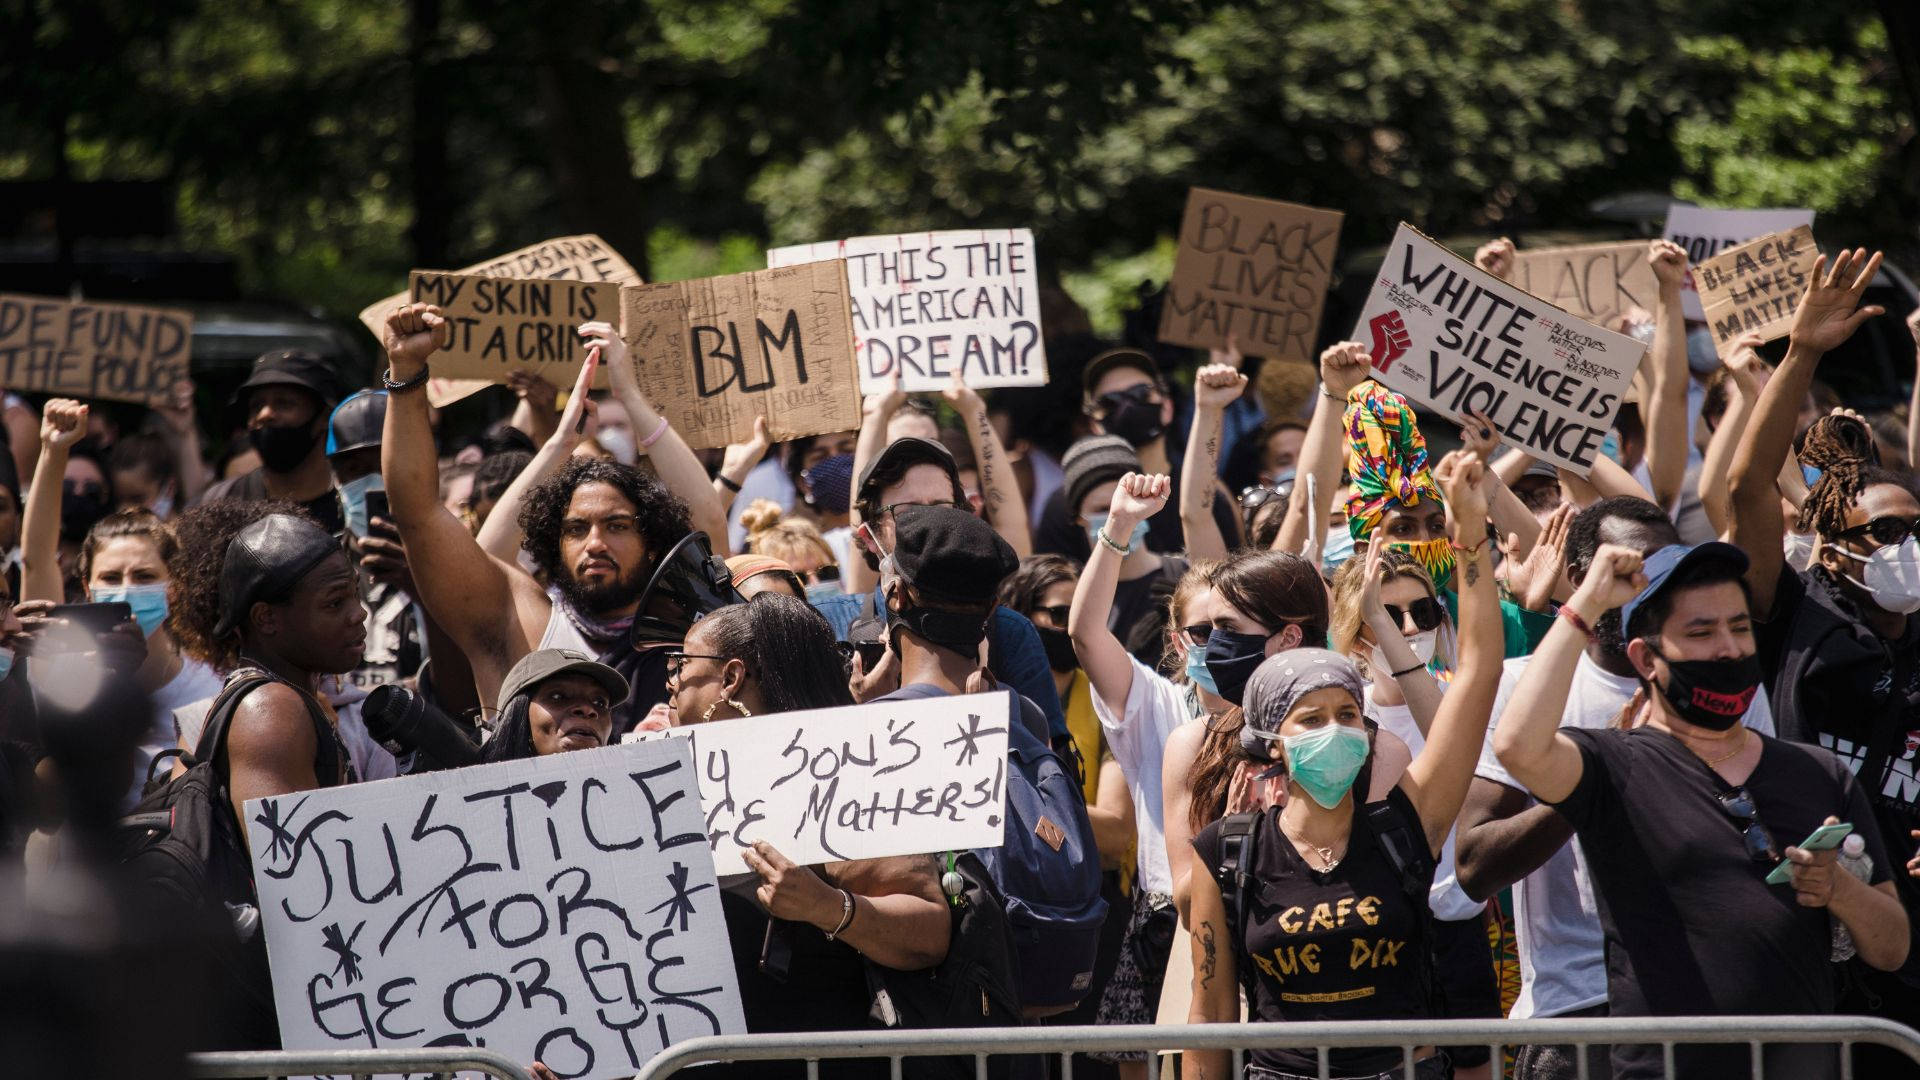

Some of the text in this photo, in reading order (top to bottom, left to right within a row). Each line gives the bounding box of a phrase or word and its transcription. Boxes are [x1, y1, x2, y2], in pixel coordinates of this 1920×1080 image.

[847, 241, 1027, 288] THIS THE
[1187, 203, 1335, 273] BLACK
[1702, 236, 1803, 291] BLACK
[416, 276, 597, 320] MY SKIN IS
[850, 286, 1025, 331] AMERICAN
[1209, 256, 1316, 309] LIVES
[1401, 244, 1537, 348] WHITE
[1523, 251, 1644, 317] LACK
[1729, 262, 1805, 306] LIVES
[1166, 290, 1310, 358] MATTER
[1715, 285, 1808, 343] MATTE
[0, 344, 89, 391] THE
[481, 326, 507, 363] A
[517, 322, 607, 366] CRIM
[691, 308, 809, 398] BLM
[866, 320, 1039, 379] DREAM?
[1435, 317, 1618, 420] SILENCE IS
[1429, 349, 1606, 468] VIOLENCE
[770, 718, 921, 790] SON'S
[416, 865, 643, 950] FOR
[1278, 895, 1383, 934] CAFE
[1350, 937, 1407, 970] DIX
[306, 929, 724, 1049] GEORGE
